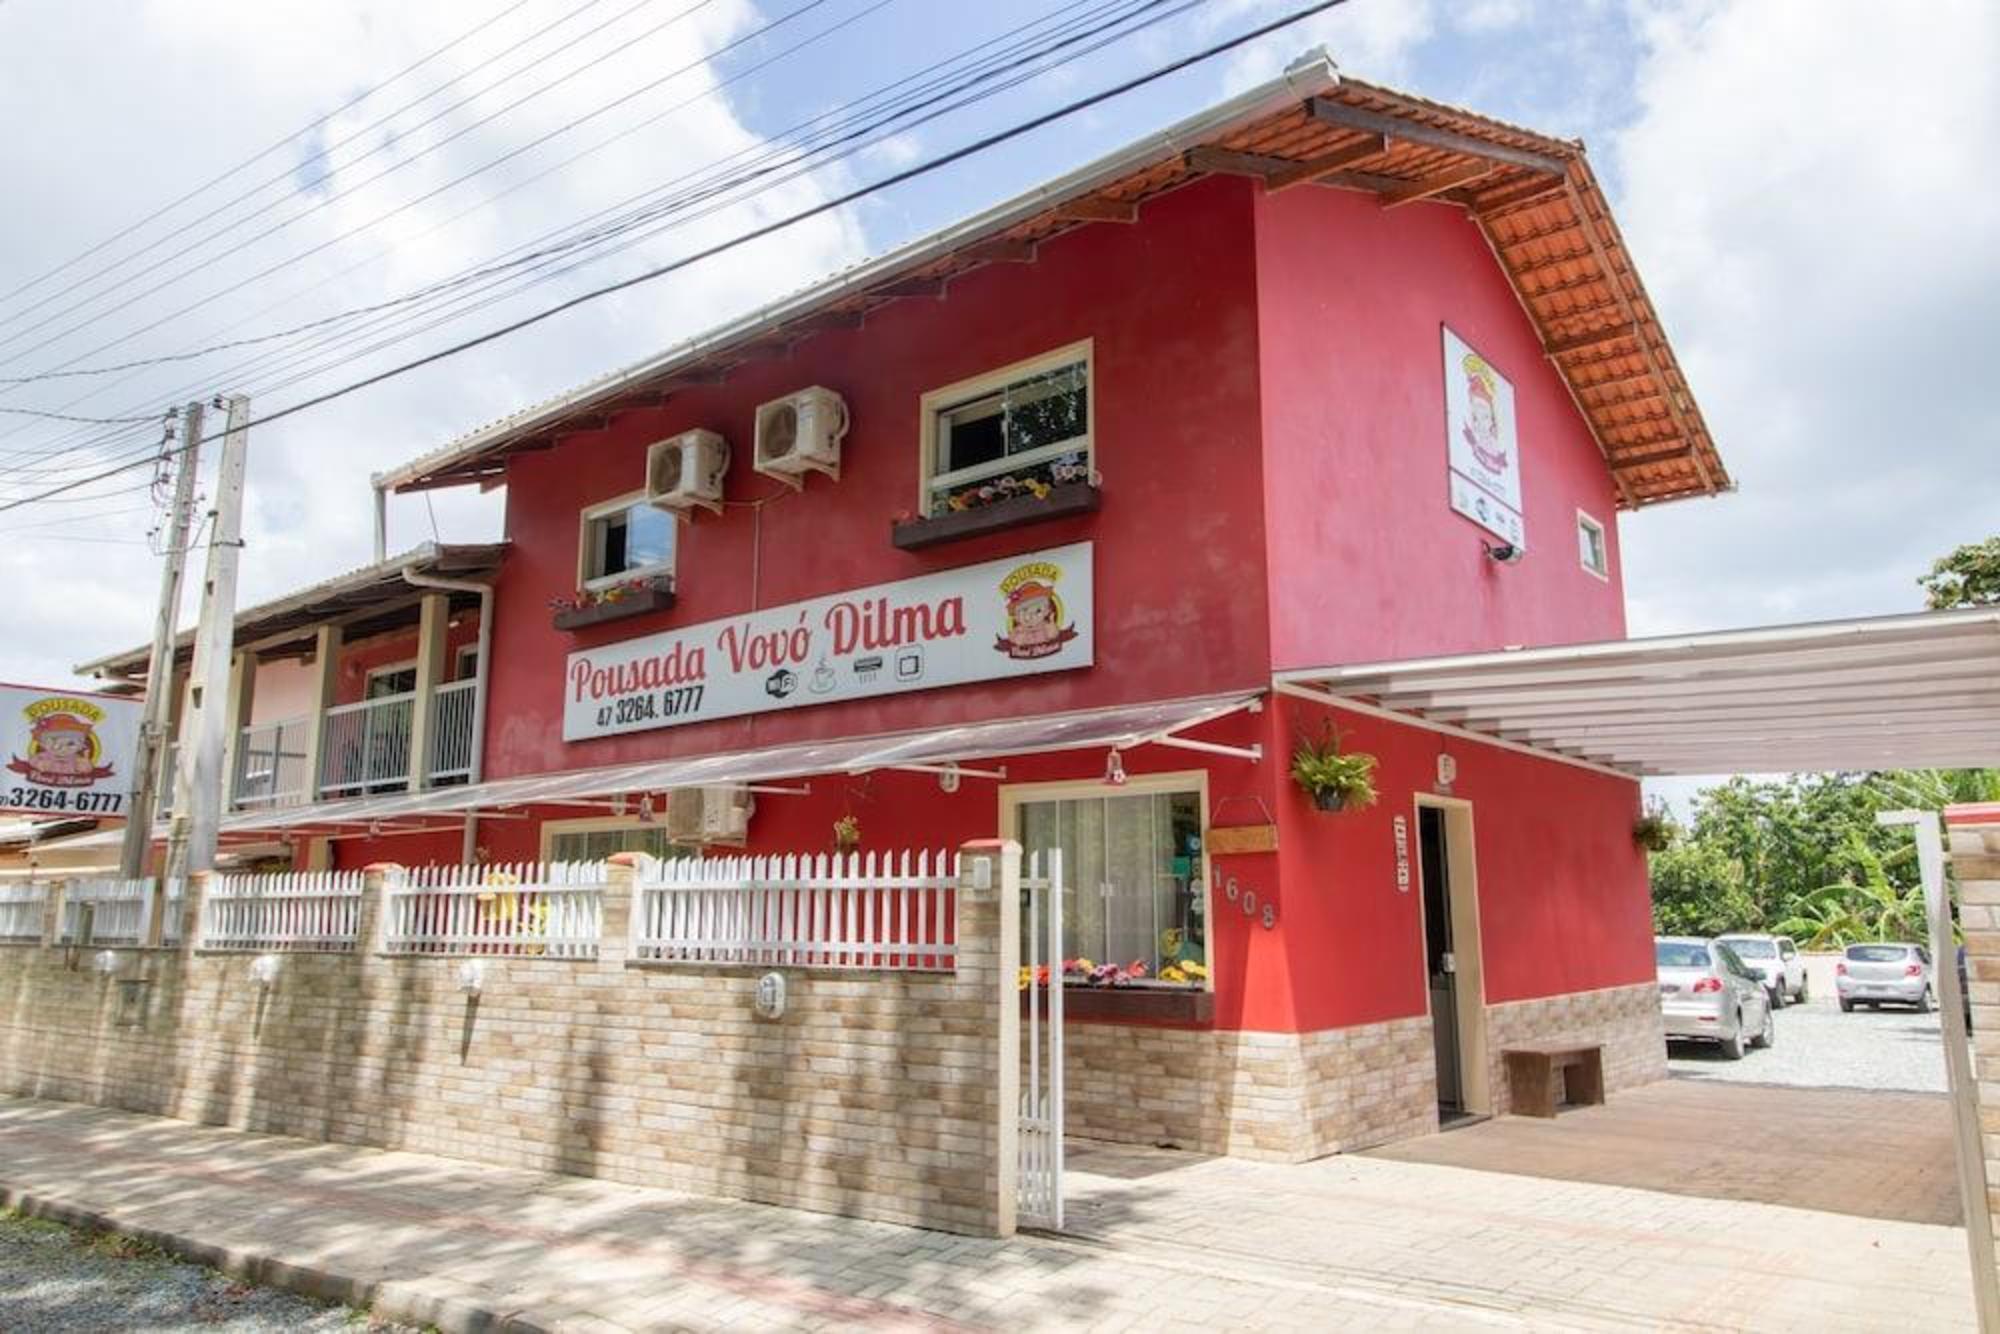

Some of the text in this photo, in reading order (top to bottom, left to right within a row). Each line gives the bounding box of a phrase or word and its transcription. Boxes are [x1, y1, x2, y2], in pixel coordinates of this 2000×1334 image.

[571, 597, 966, 702] Pousada Vovó Dilma
[597, 685, 704, 727] 47 3264. 6777
[10, 788, 122, 812] 3264-6777
[1213, 864, 1275, 928] 1608
